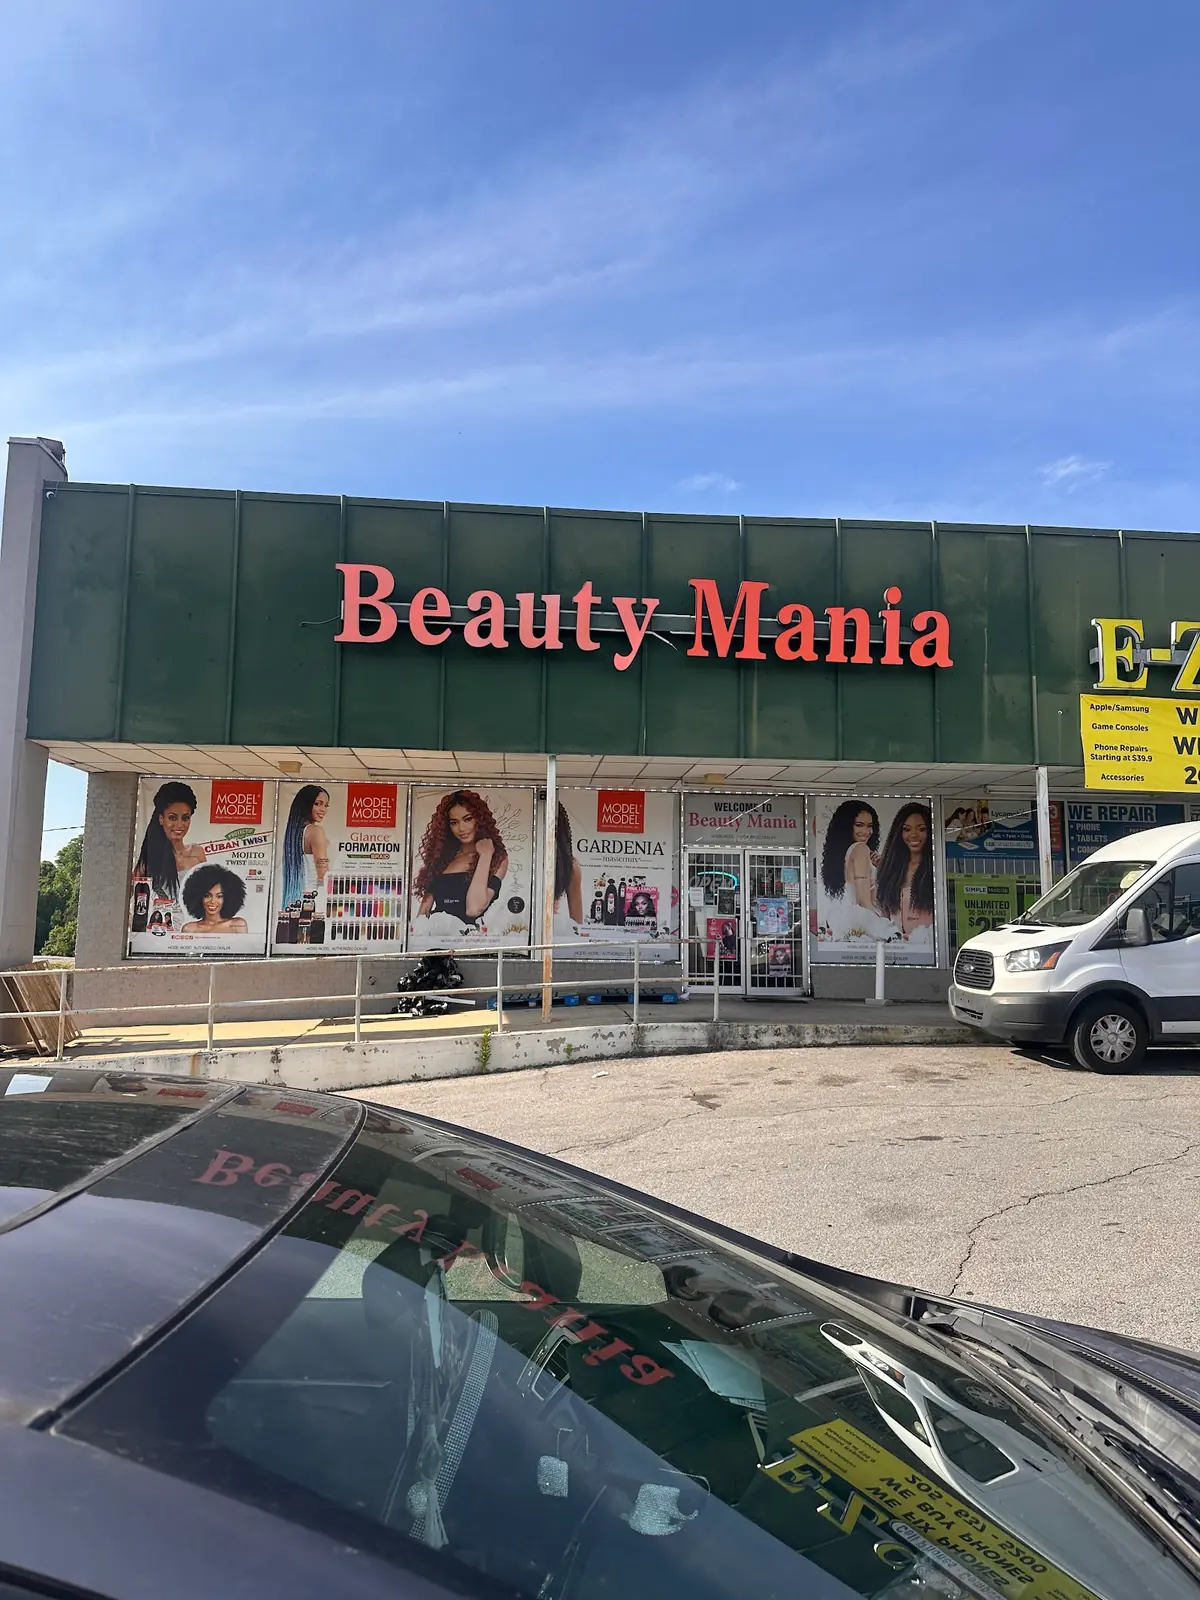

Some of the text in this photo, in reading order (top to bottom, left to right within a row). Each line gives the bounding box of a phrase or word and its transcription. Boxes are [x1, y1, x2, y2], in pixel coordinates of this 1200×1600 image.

[334, 562, 954, 671] Beauty Mania
[1089, 703, 1150, 713] Apple/Samsung
[1176, 707, 1199, 725] W
[1091, 723, 1149, 732] Game Consoles
[1094, 743, 1149, 753] Phone Repairs
[1173, 736, 1200, 755] W
[1090, 753, 1121, 763] Starting
[1122, 754, 1131, 762] at
[1100, 773, 1145, 782] Accessories
[1184, 766, 1200, 785] 2
[216, 793, 258, 804] MODEL
[352, 797, 392, 808] MODEL
[215, 804, 257, 815] MODEL
[602, 803, 640, 814] MODEL
[714, 802, 772, 812] WELCOME TO
[351, 808, 392, 819] MODEL
[1068, 805, 1156, 822] WE REPAIR
[601, 814, 640, 825] MODEL
[688, 812, 797, 832] Beauty Mania
[1076, 823, 1101, 831] PHONE
[350, 832, 390, 842] Glance
[1076, 834, 1108, 842] TABLETS
[204, 835, 268, 853] CUBAN TWIST
[338, 842, 400, 853] FORMATION
[577, 839, 664, 856] GARDENIA
[231, 851, 265, 859] MOJITO
[965, 900, 1010, 910] UNLIMITED
